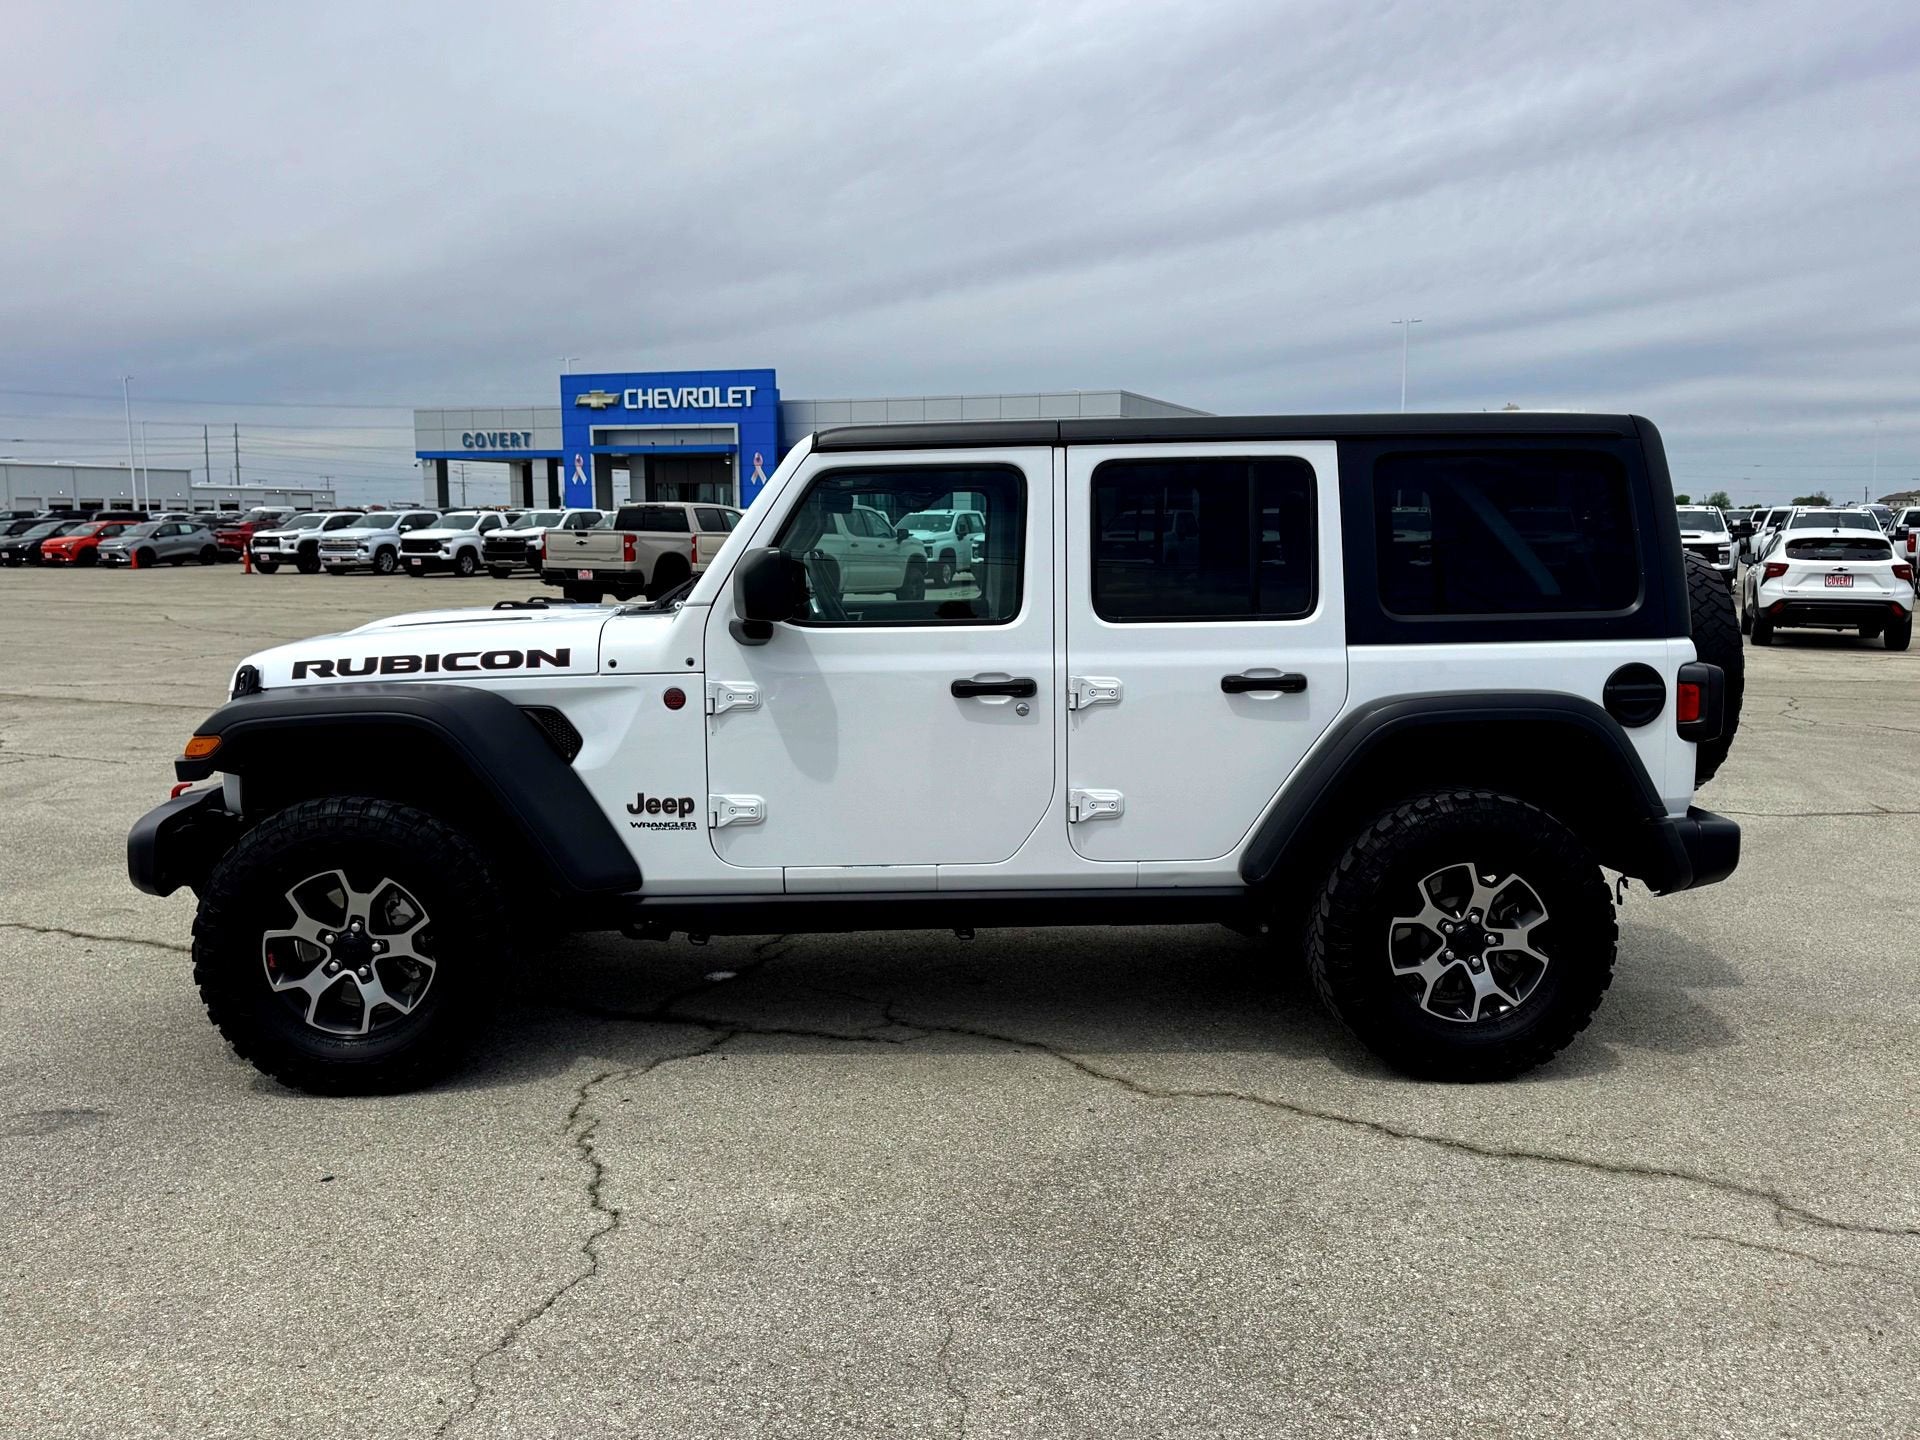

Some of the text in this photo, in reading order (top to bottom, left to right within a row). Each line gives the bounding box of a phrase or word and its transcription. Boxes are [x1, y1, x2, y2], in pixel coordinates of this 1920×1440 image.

[623, 386, 756, 409] CHEVROLET
[462, 432, 532, 448] COVERT
[1827, 575, 1852, 585] COVERT
[292, 648, 571, 680] RUBICON
[626, 792, 695, 818] Jeep
